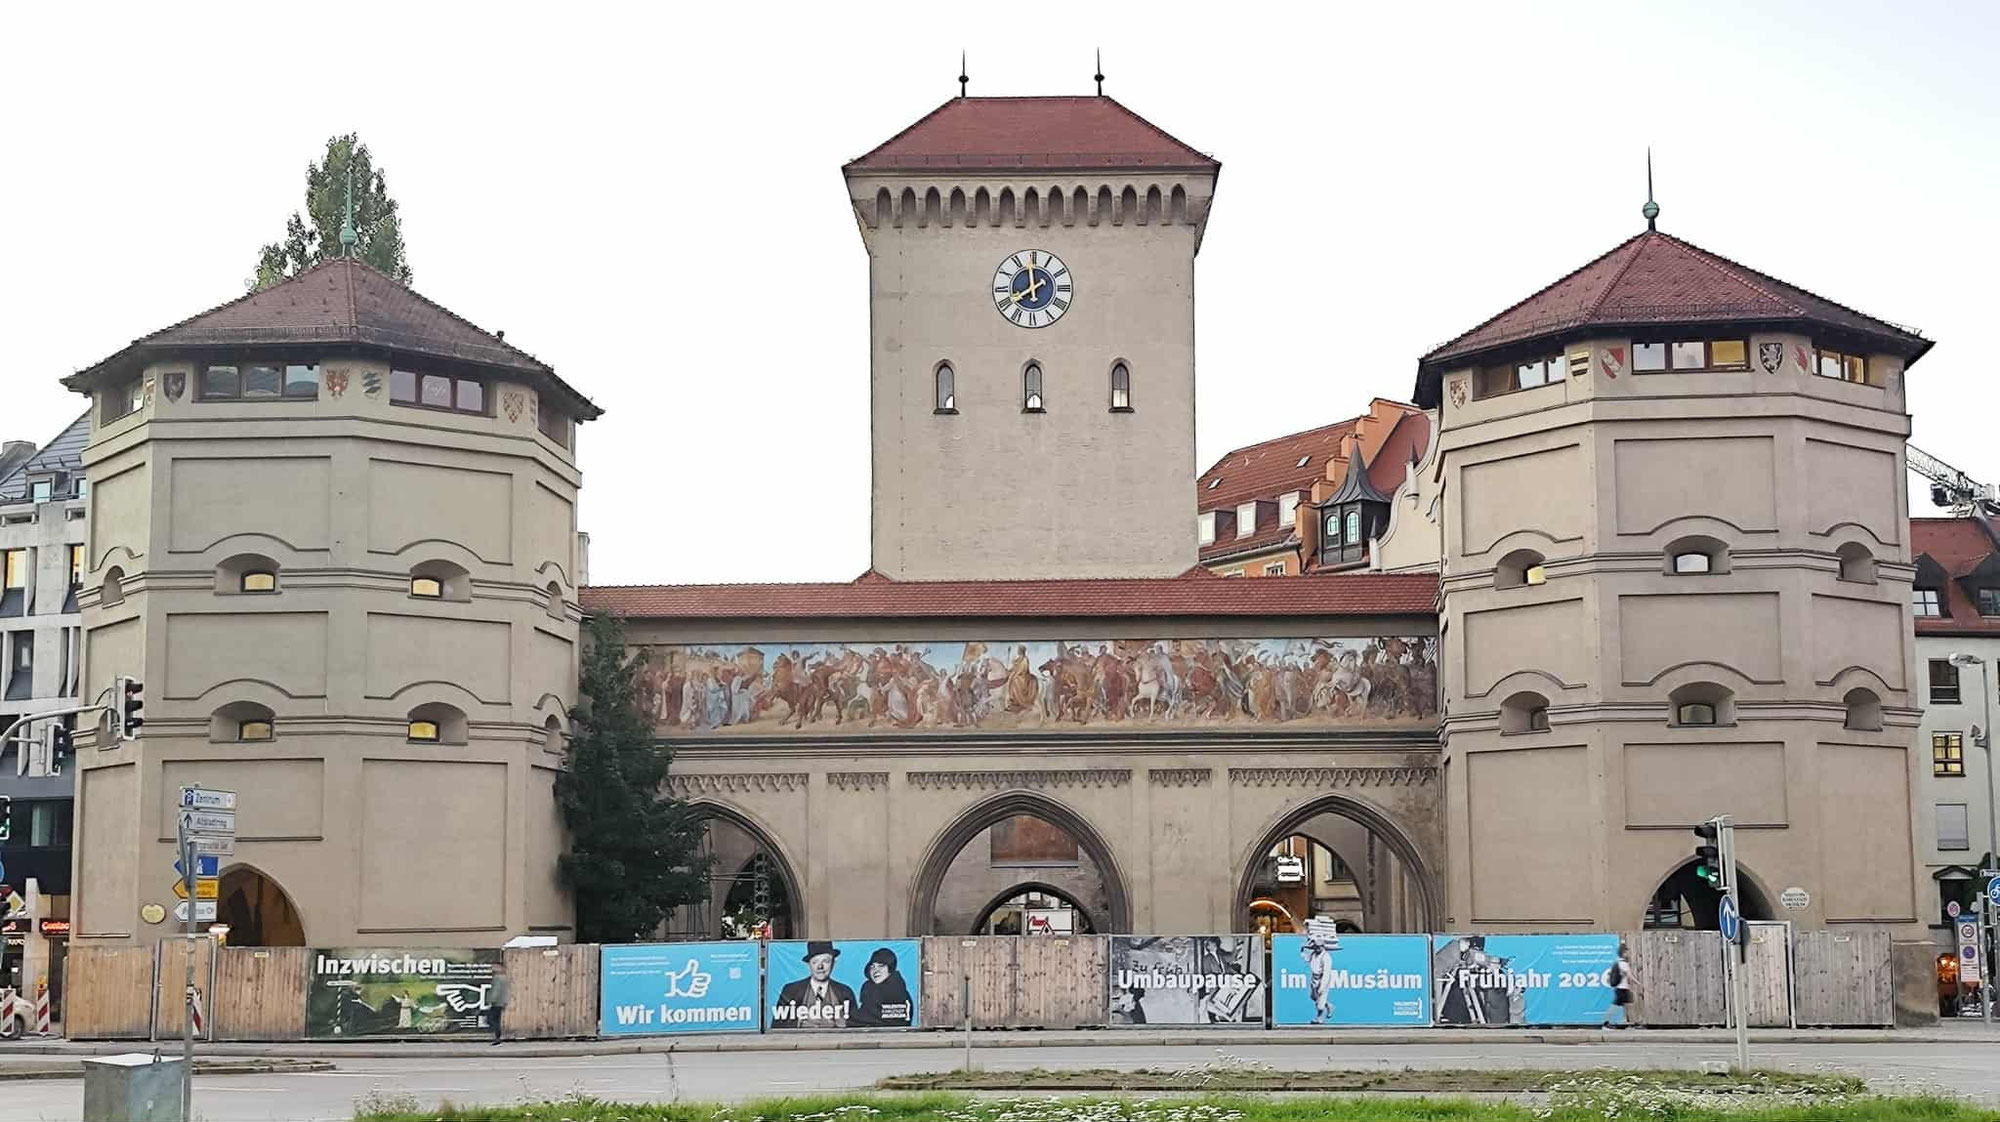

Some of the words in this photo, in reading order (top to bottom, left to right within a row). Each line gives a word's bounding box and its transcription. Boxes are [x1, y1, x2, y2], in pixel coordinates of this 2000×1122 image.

[317, 954, 446, 974] Inzwischen
[1118, 969, 1256, 993] Umbaupause
[1280, 968, 1307, 988] im
[1328, 969, 1422, 989] Musäum
[1459, 968, 1552, 997] Frühjahr
[616, 1004, 655, 1024] Wir
[661, 1003, 752, 1024] kommen
[773, 1000, 850, 1020] wieder!
